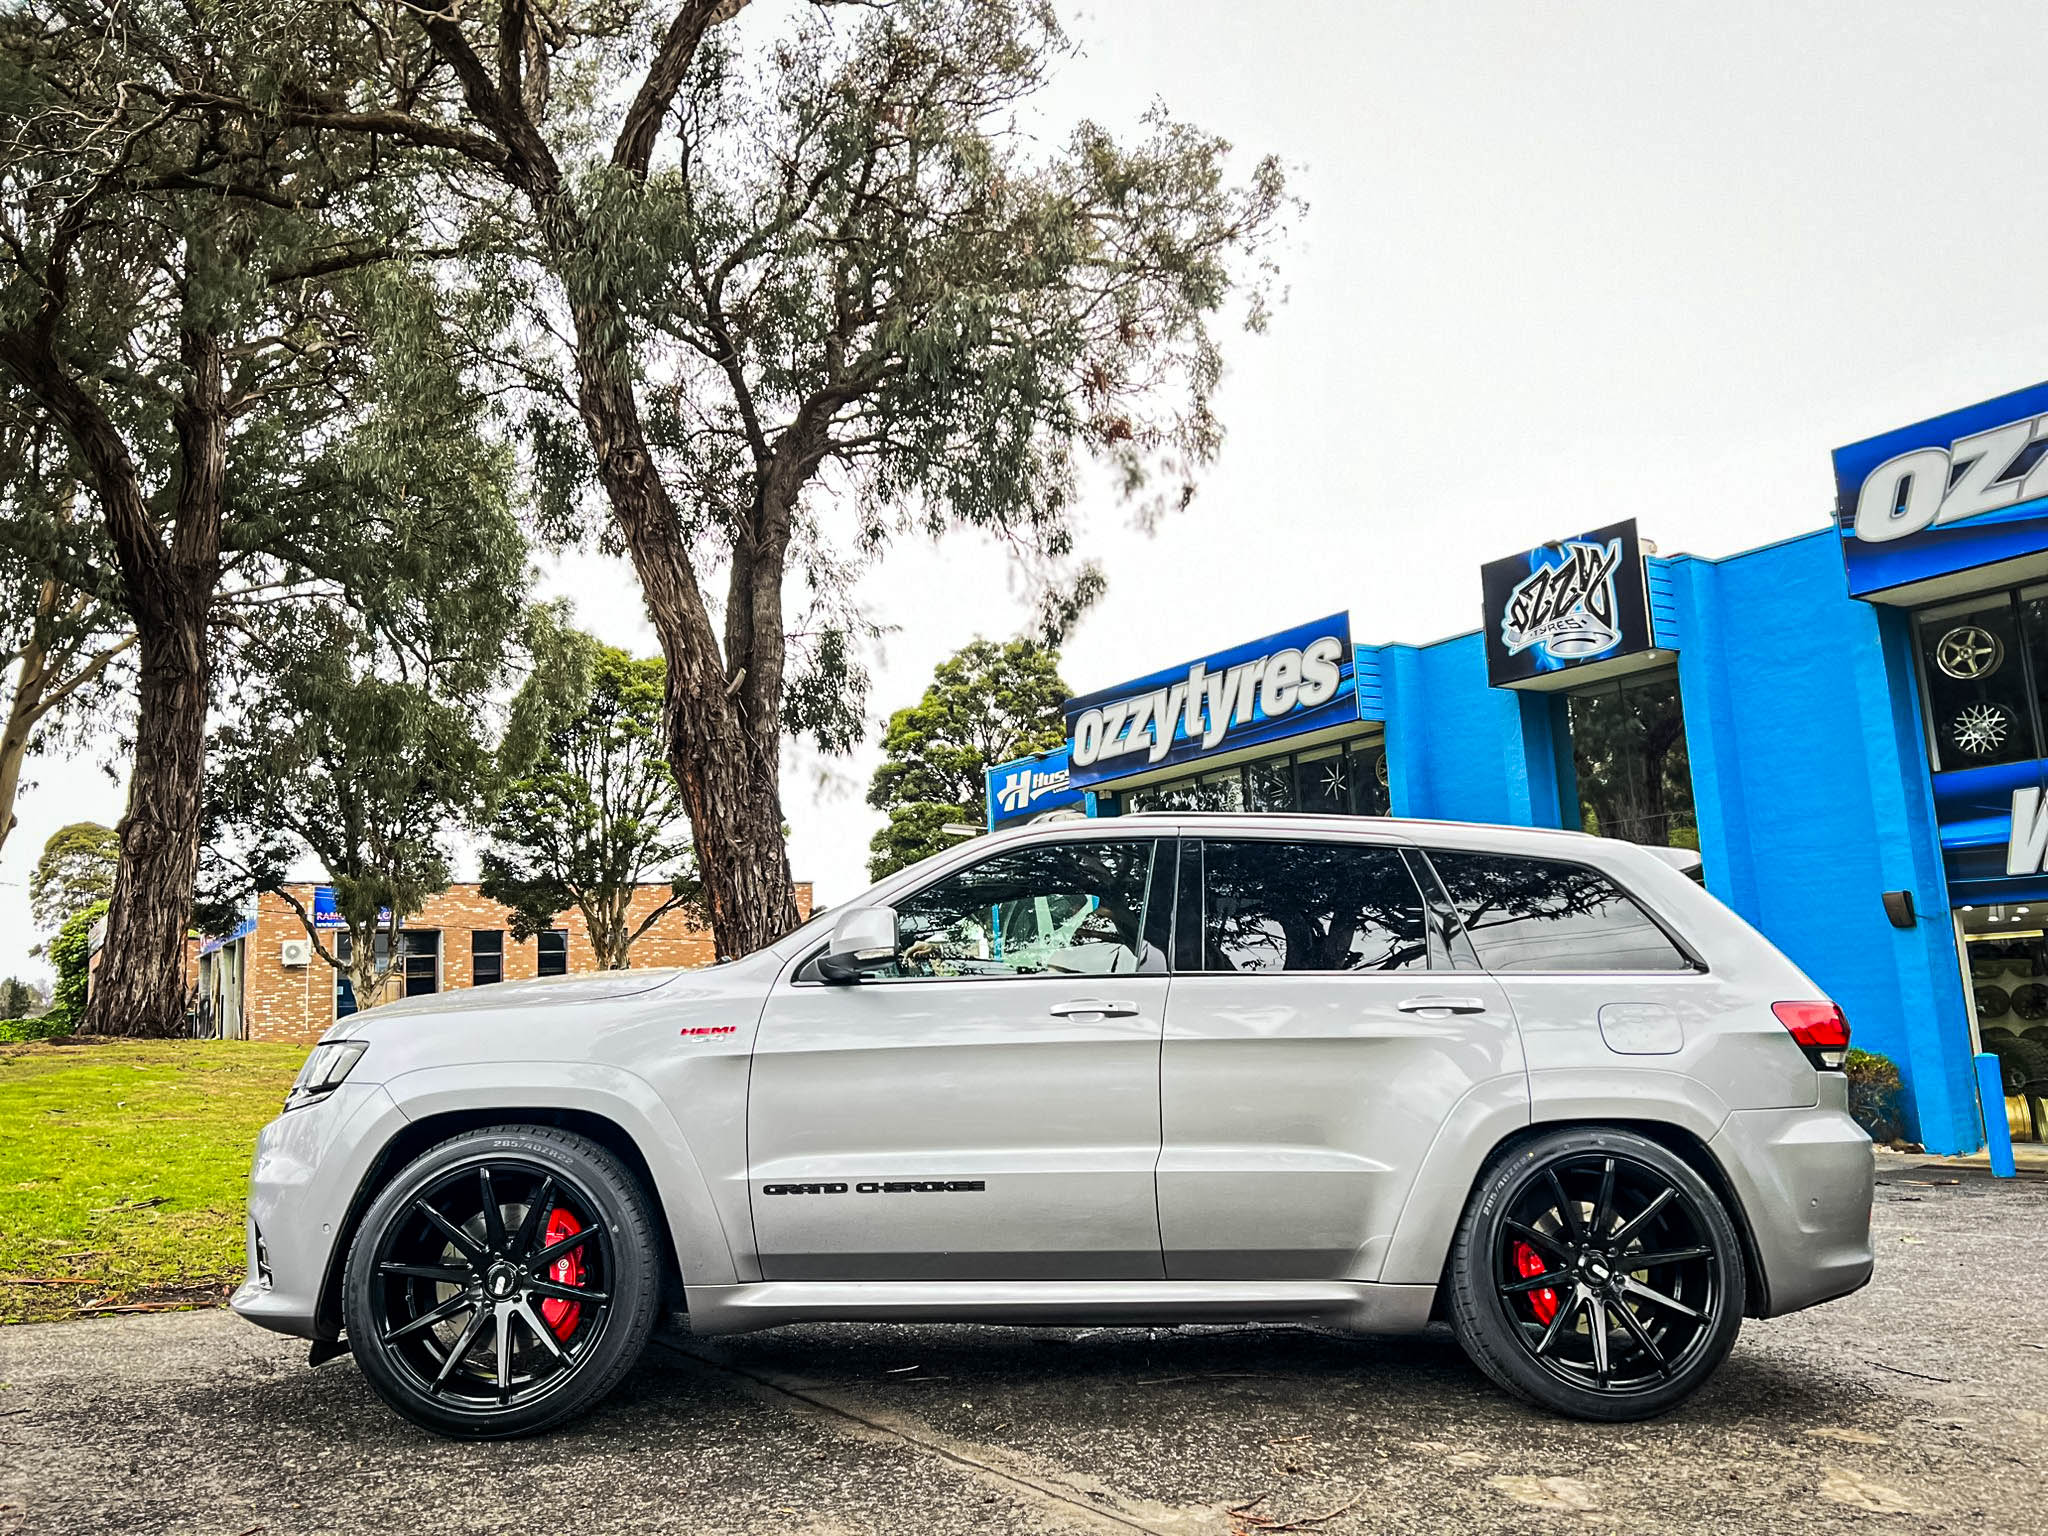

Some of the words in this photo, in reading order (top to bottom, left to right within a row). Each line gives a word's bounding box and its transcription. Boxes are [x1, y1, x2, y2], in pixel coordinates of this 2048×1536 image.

[1533, 618, 1583, 637] TYRES
[680, 1026, 737, 1036] HEMI
[762, 1182, 849, 1196] GRAND
[855, 1180, 986, 1194] CHEROKEE
